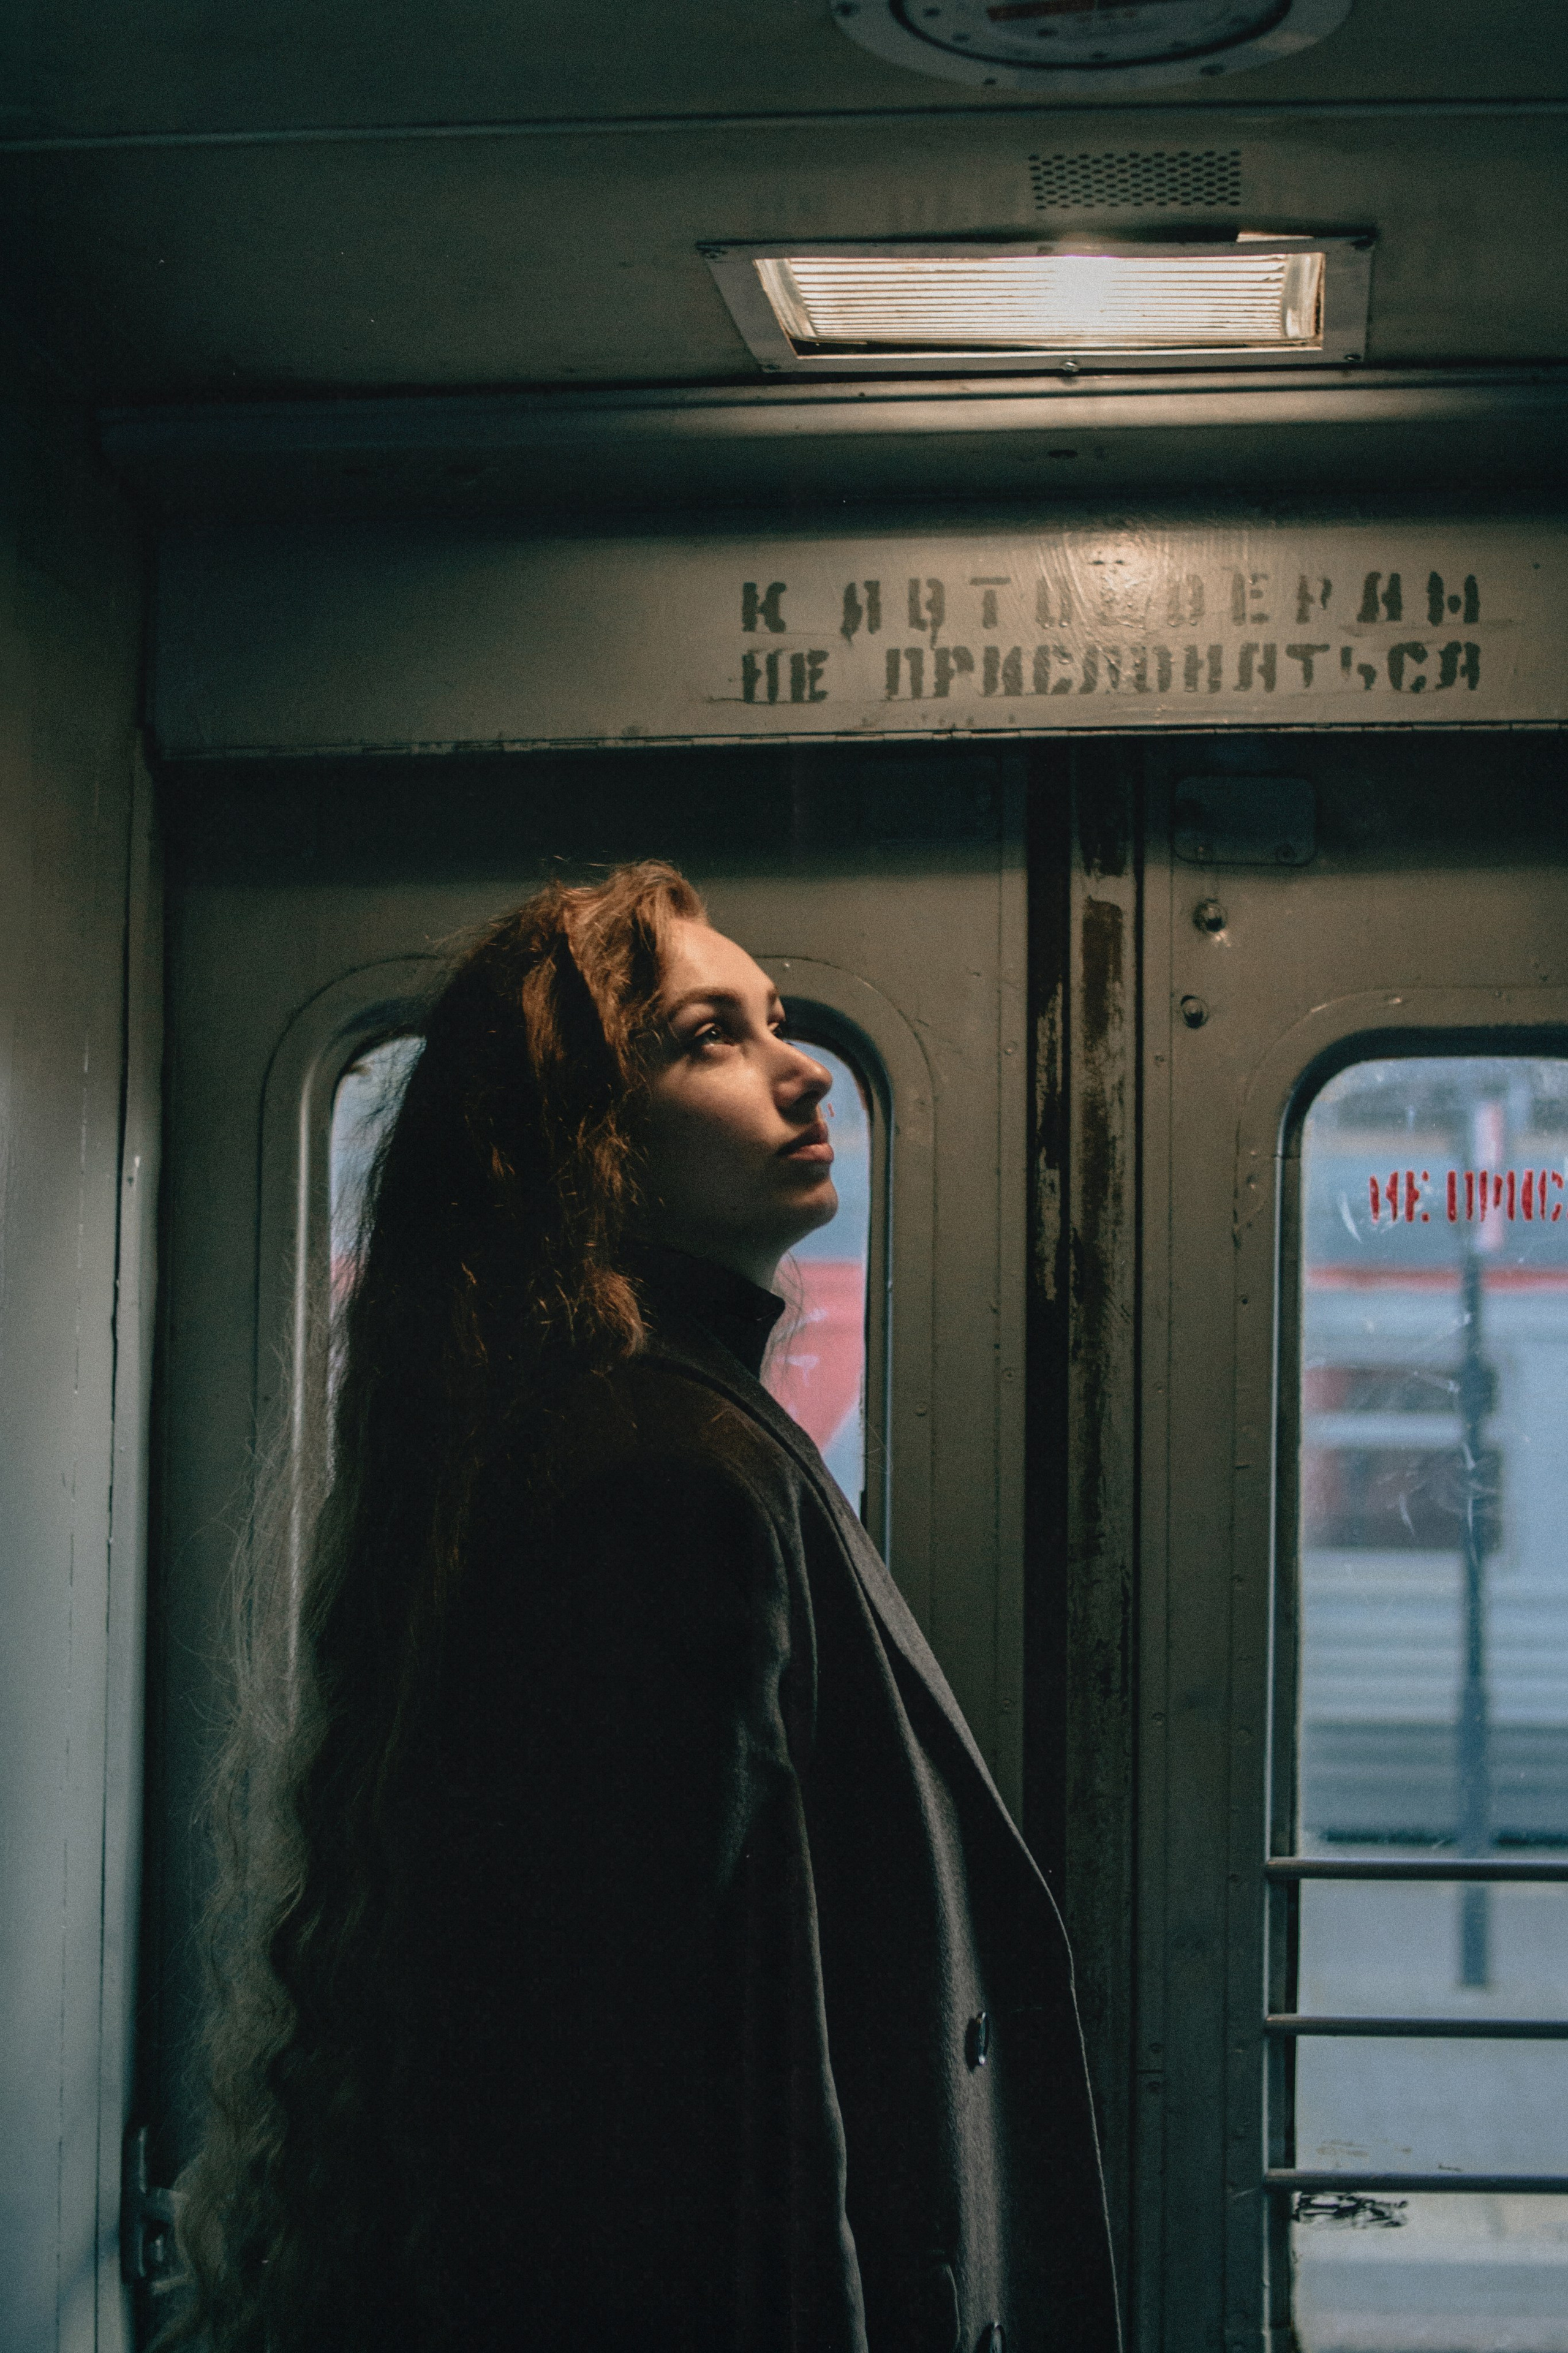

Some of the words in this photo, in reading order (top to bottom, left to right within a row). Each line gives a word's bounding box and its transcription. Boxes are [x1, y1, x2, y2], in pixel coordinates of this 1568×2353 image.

[742, 581, 787, 633] К
[742, 648, 830, 704] НЕ
[885, 641, 1480, 701] ПРИСЛОНЯТЬСЯ
[1369, 1171, 1430, 1223] НЕ
[1446, 1169, 1568, 1223] ПРИС
